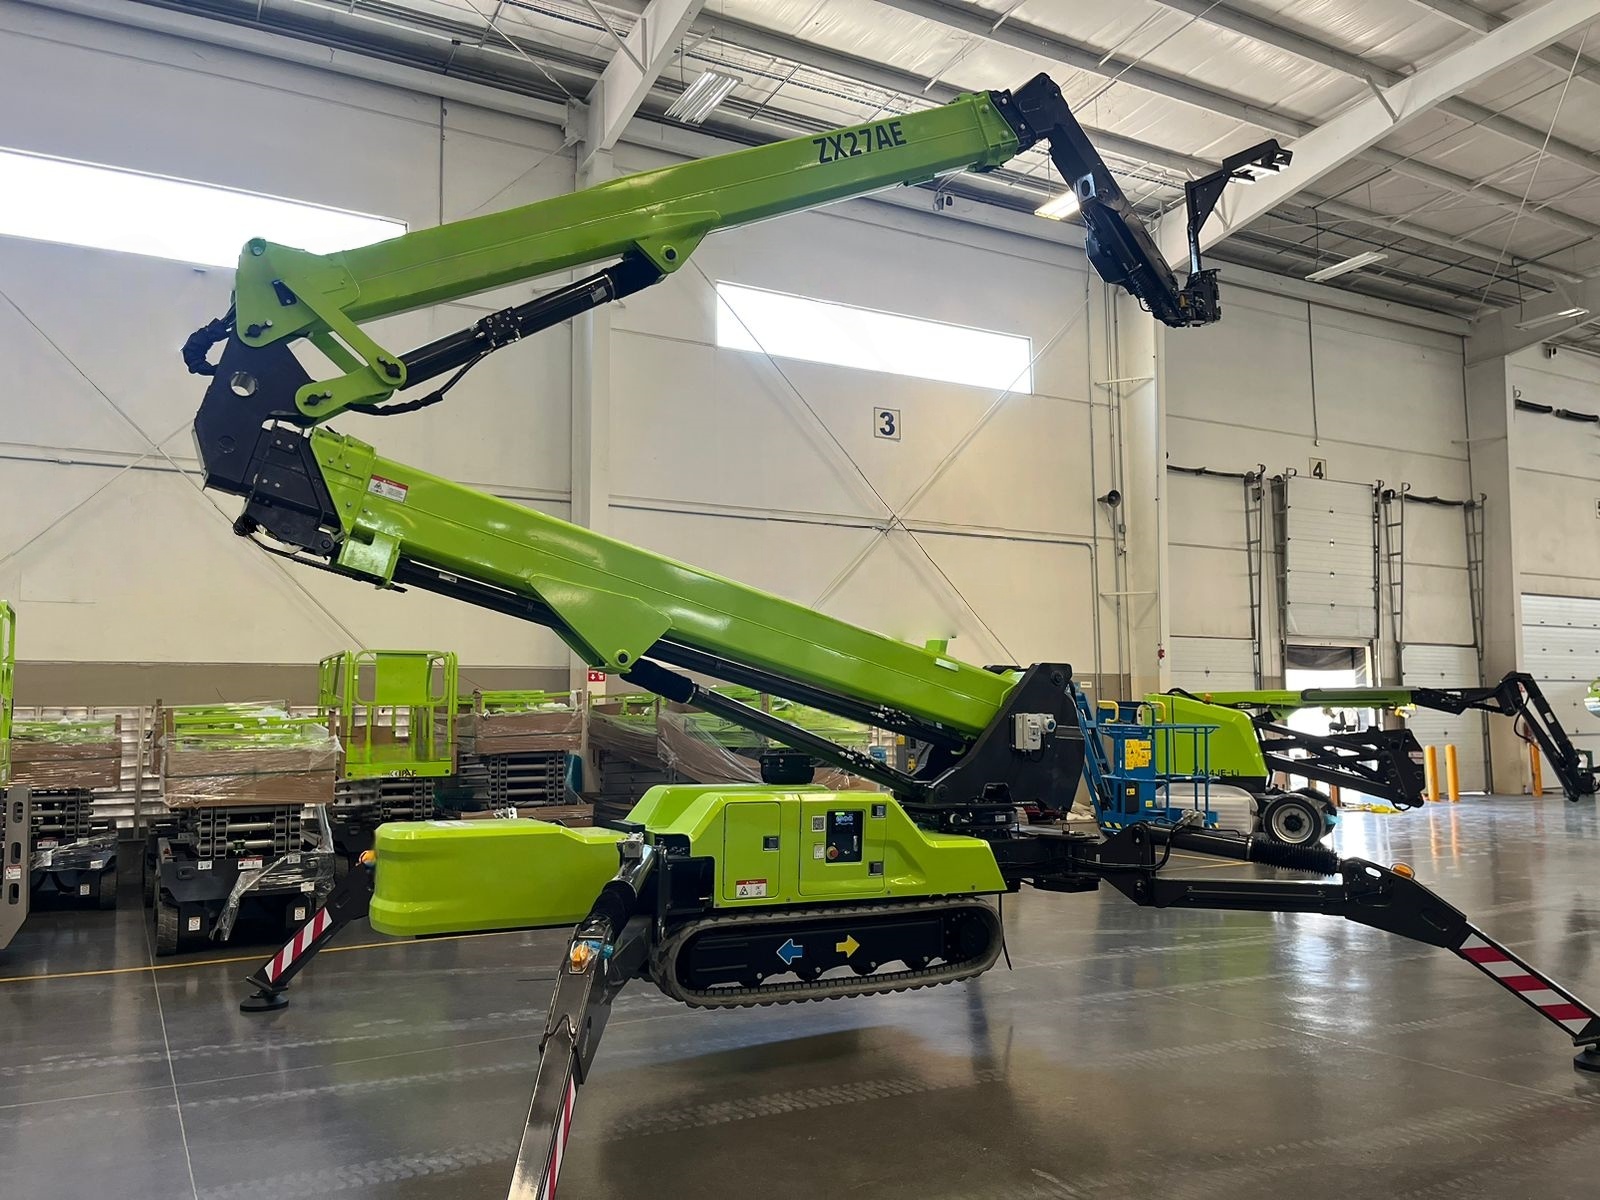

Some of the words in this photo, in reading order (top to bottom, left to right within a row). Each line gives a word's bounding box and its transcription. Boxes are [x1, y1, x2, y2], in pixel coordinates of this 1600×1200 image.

[812, 121, 907, 164] ZX27AE
[879, 411, 895, 436] 3
[1312, 461, 1323, 479] 4
